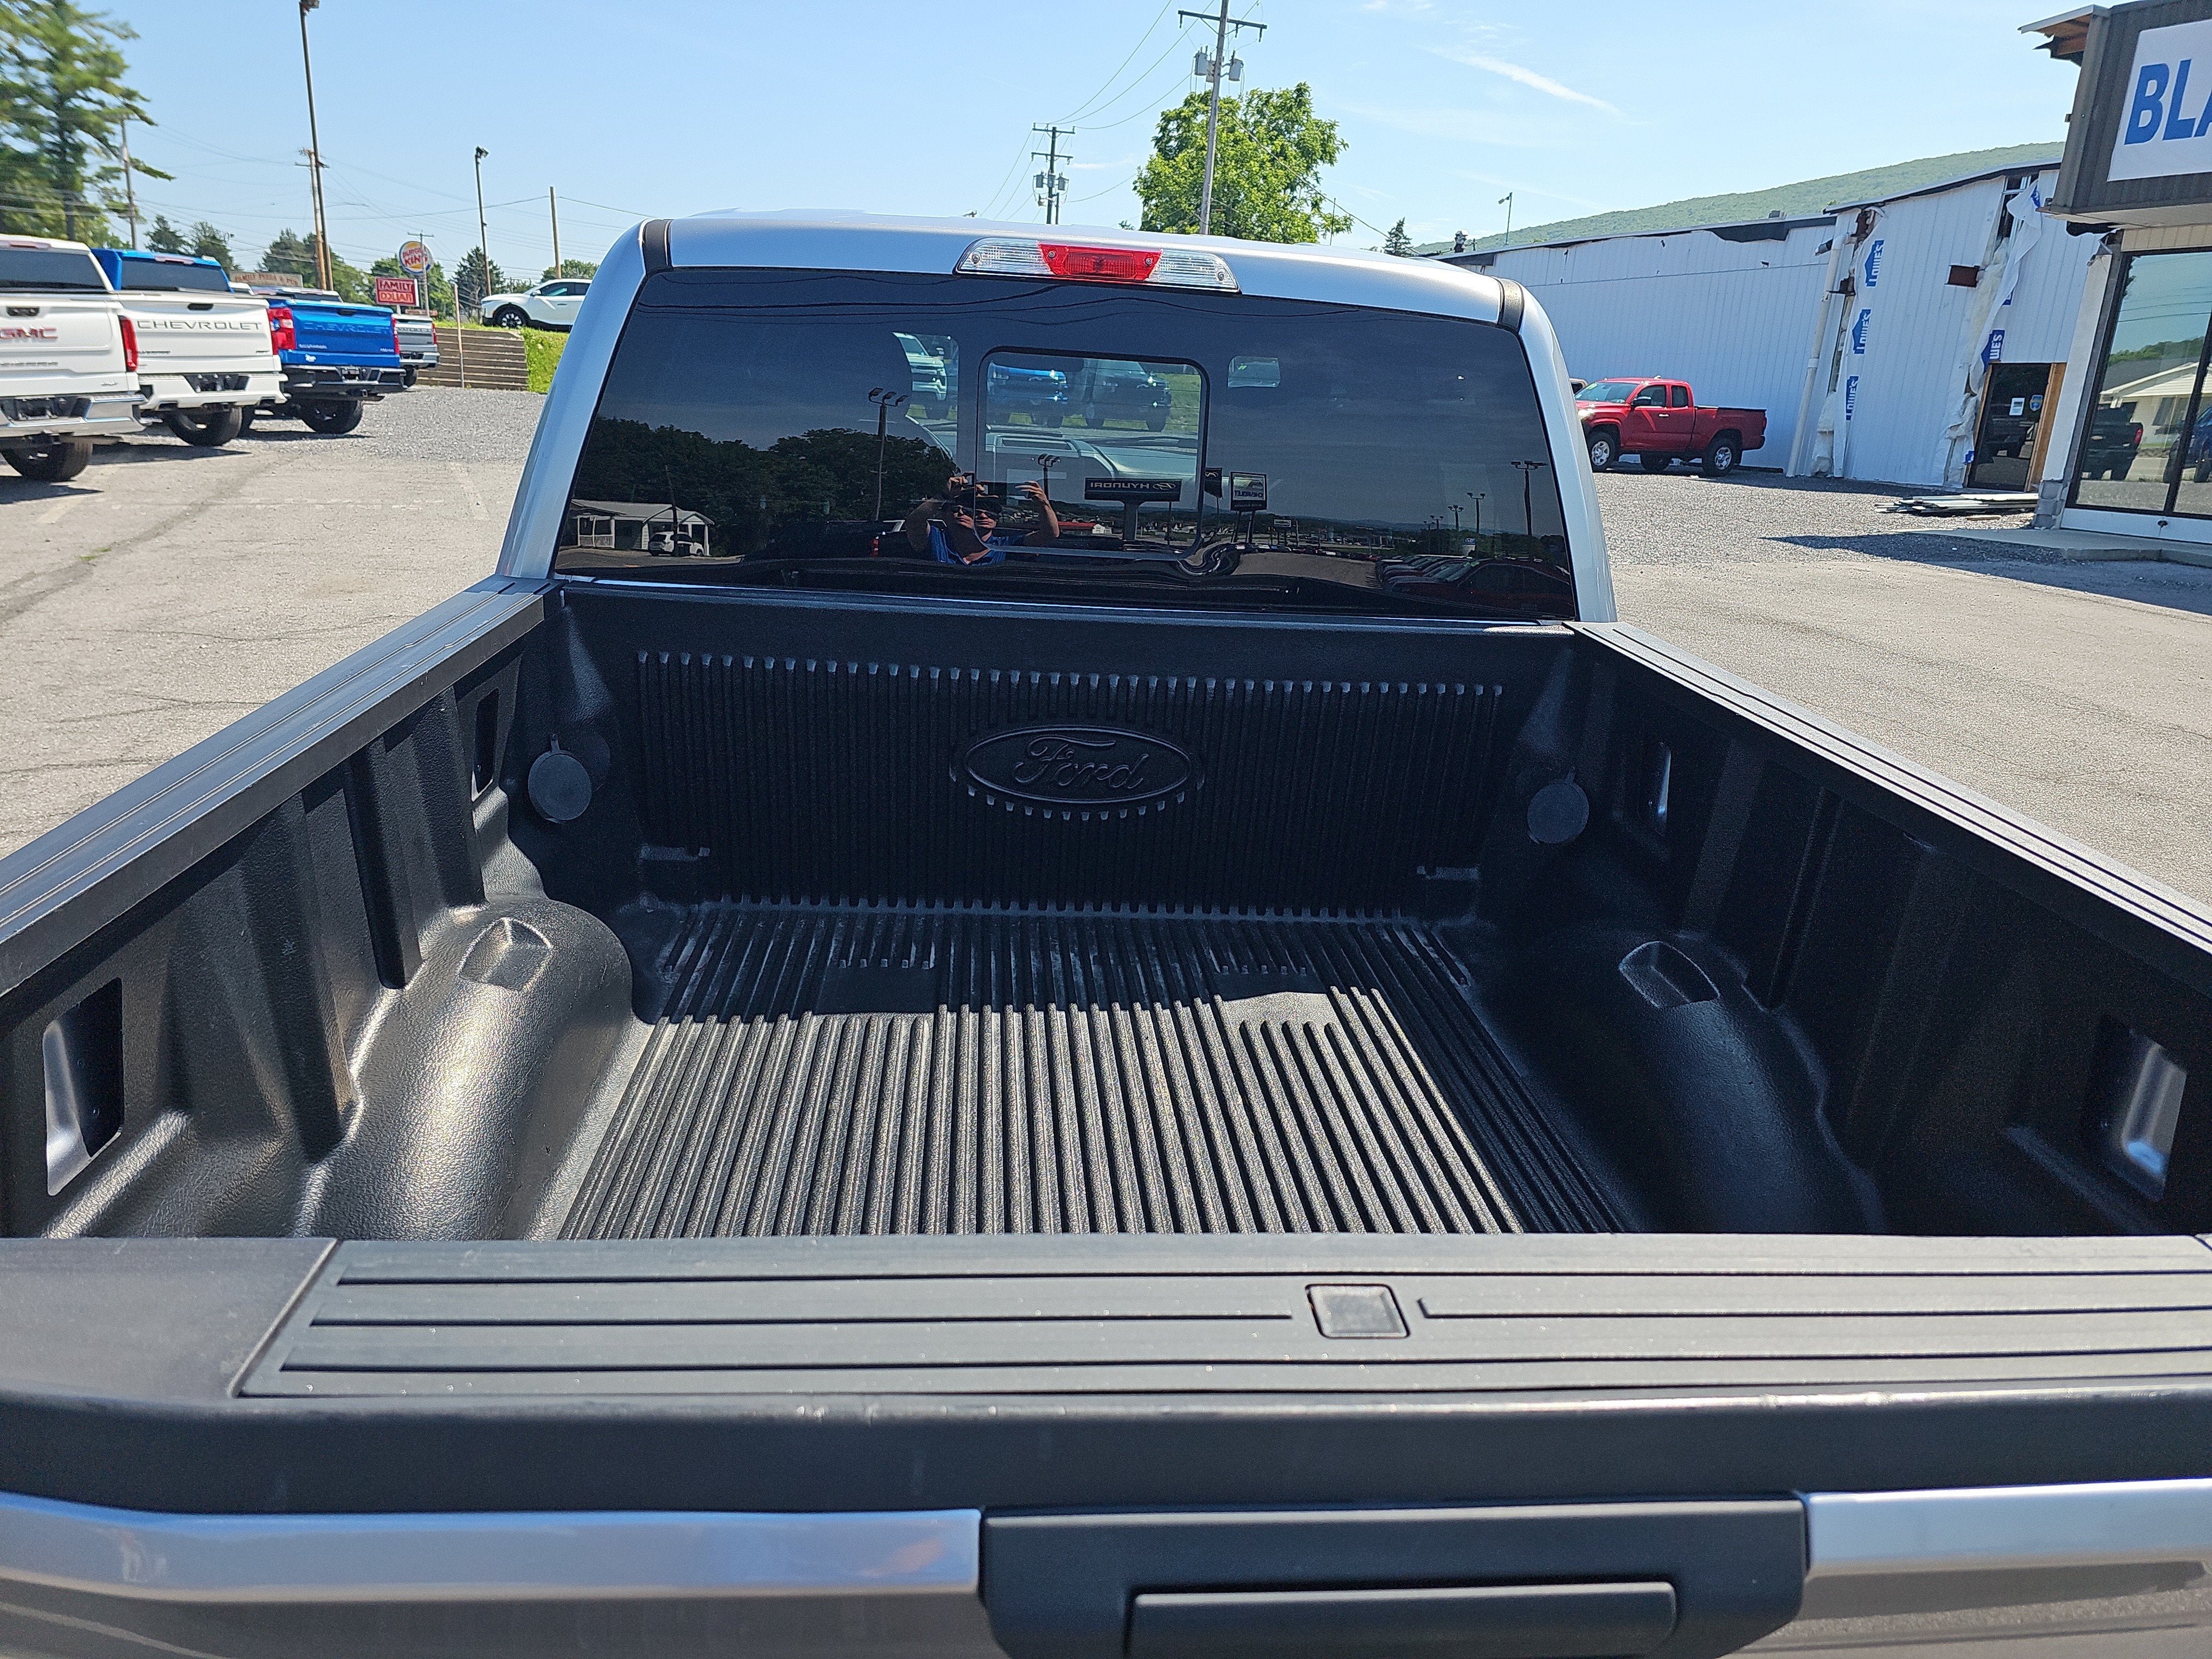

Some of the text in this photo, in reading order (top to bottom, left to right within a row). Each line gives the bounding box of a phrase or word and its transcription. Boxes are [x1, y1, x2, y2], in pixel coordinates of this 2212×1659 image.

[380, 281, 412, 291] FAMILY
[137, 320, 262, 330] CHEVROLET
[0, 327, 58, 339] GMC
[1014, 734, 1149, 789] Ford
